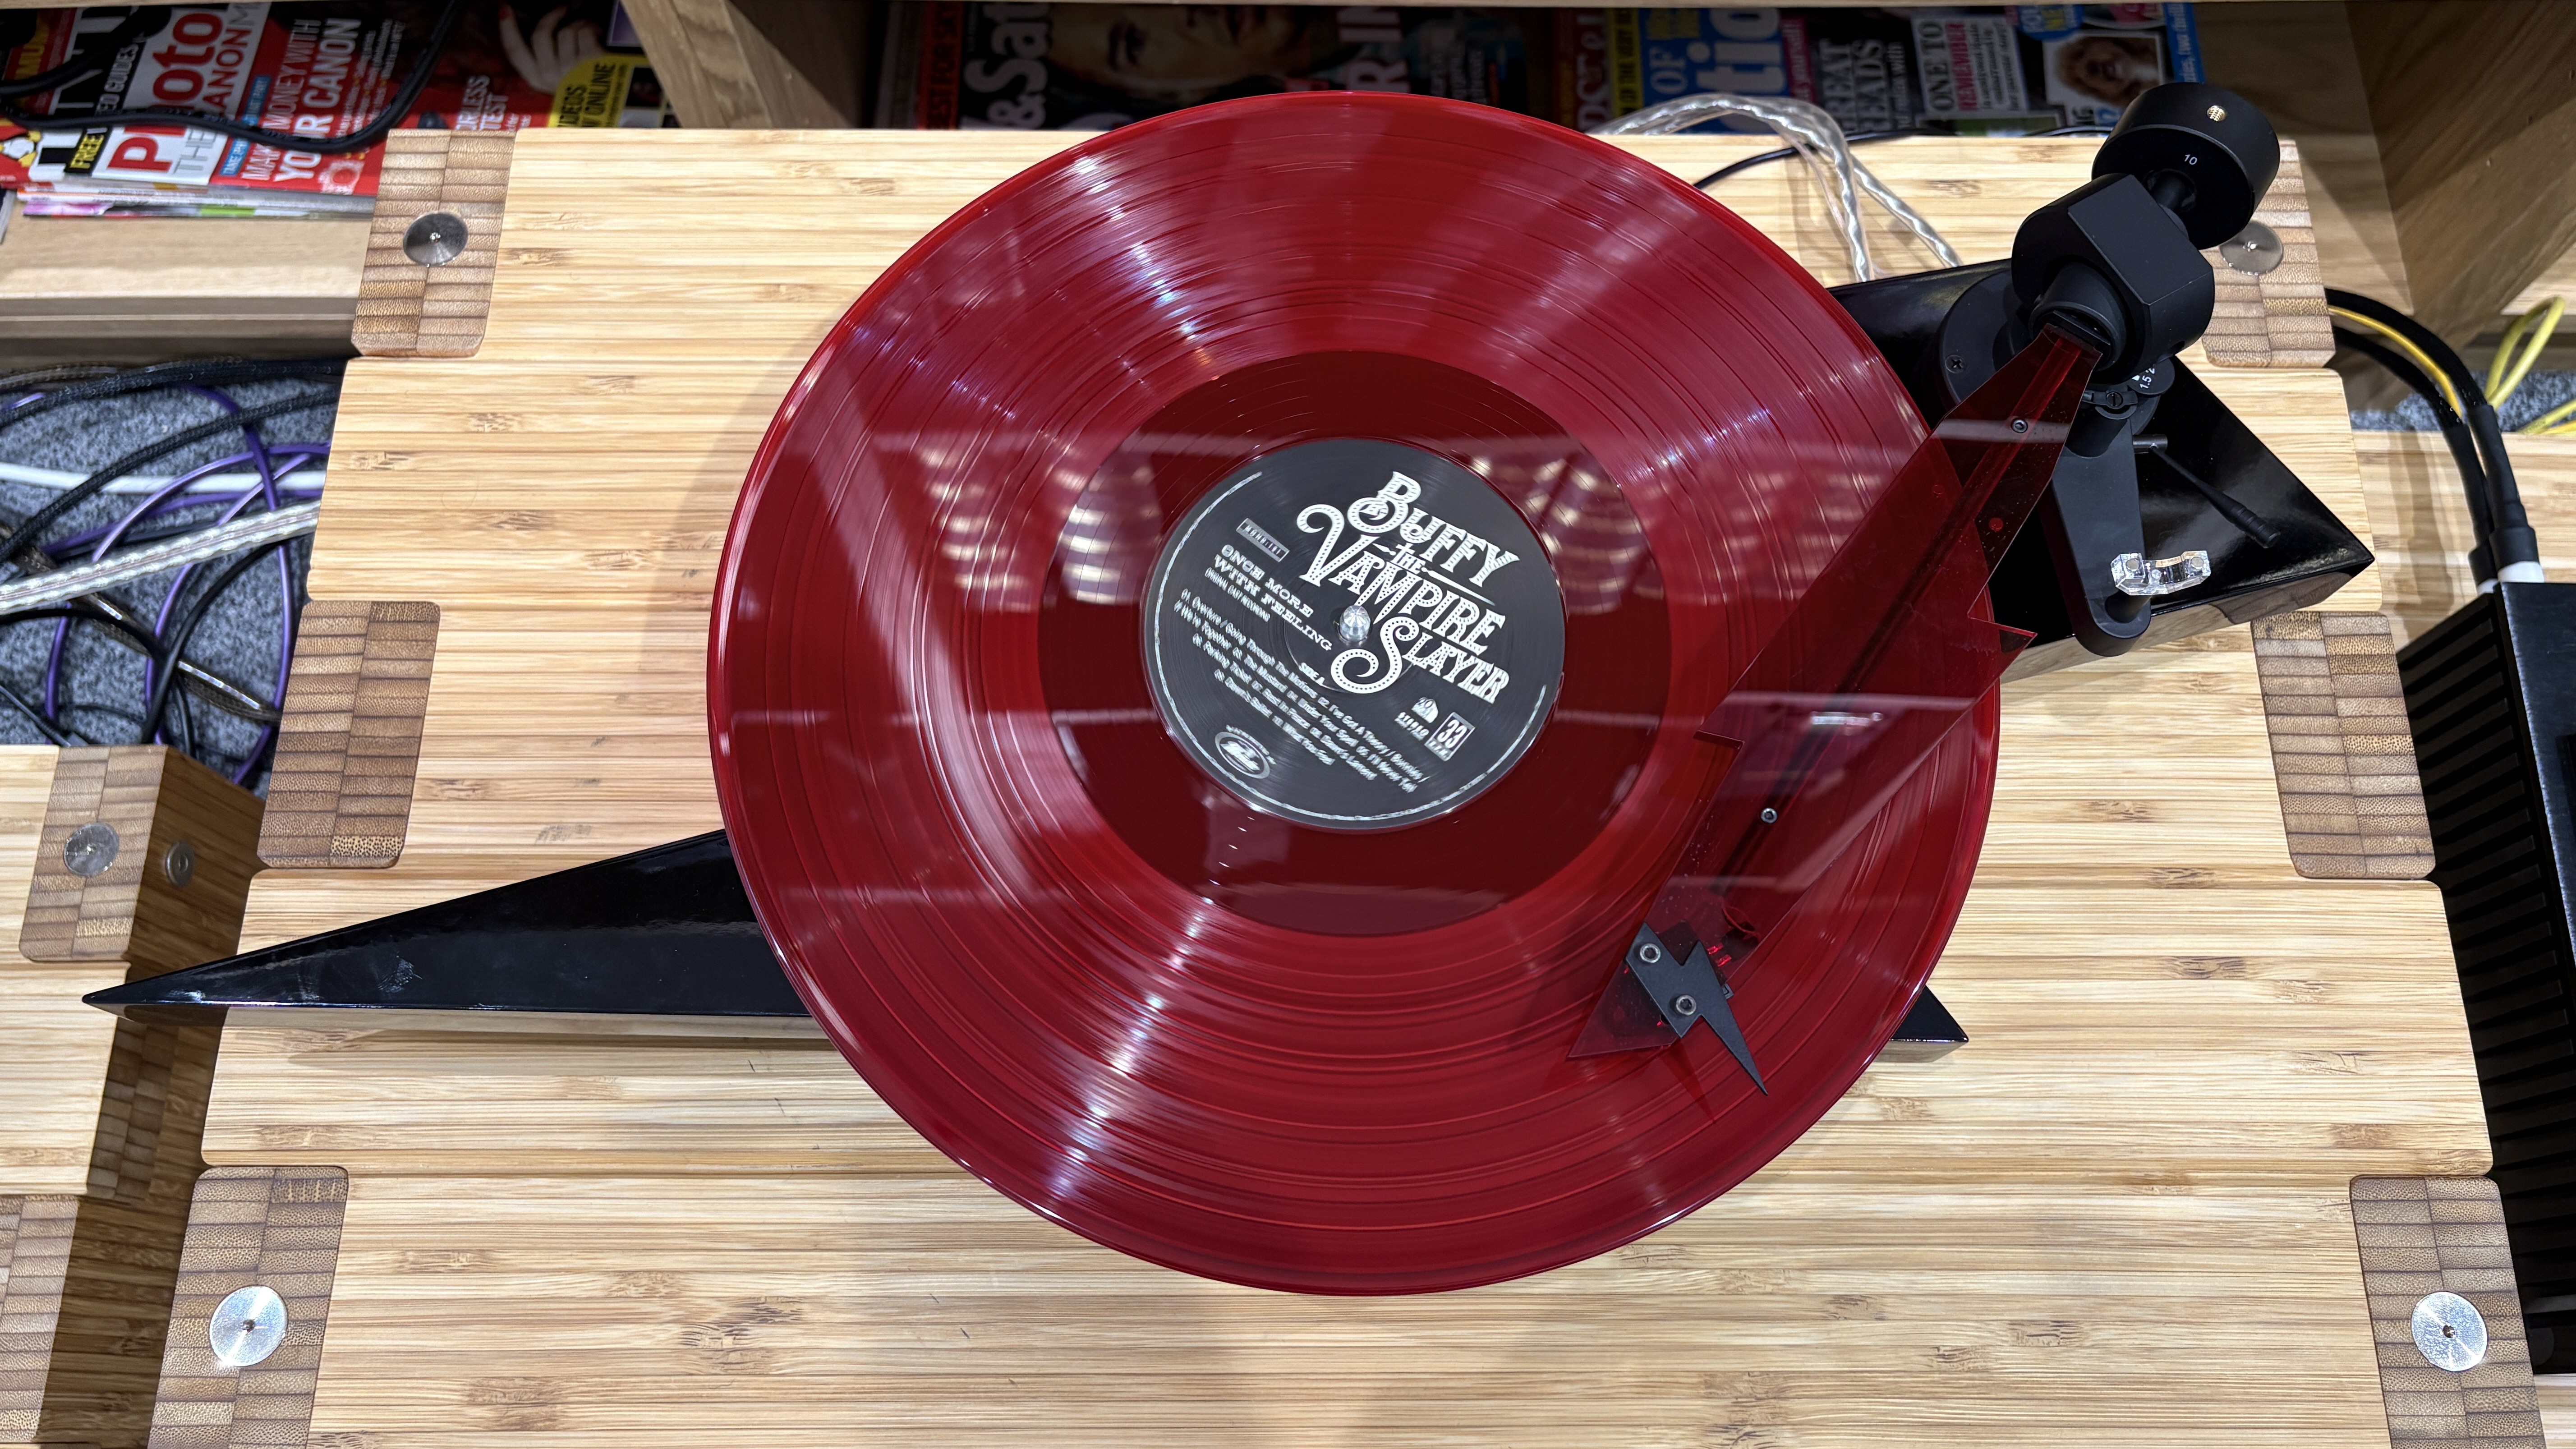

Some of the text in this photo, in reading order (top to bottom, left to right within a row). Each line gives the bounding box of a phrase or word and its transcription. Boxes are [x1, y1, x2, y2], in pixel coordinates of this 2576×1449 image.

[284, 19, 322, 63] WITH
[303, 18, 361, 108] CANON
[1650, 47, 1688, 93] OF
[1919, 22, 1955, 111] ONE TO
[1946, 23, 1978, 111] REMEMBER
[202, 28, 252, 115] ANON
[263, 64, 307, 129] MONEY
[585, 63, 616, 116] ONLINE
[70, 135, 105, 169] FREE
[241, 143, 281, 180] MAK
[2185, 154, 2198, 165] 10
[2140, 376, 2152, 389] 1.5
[1347, 471, 1520, 587] BUFFY
[1214, 554, 1332, 651] WITH FEELING
[1221, 544, 1314, 617] ONCE MORE
[1297, 504, 1506, 655] VAMPIRE
[1298, 662, 1325, 686] SIDE A
[1331, 616, 1509, 704] SLAYER
[1354, 724, 1365, 735] A
[1437, 719, 1467, 749] 33
